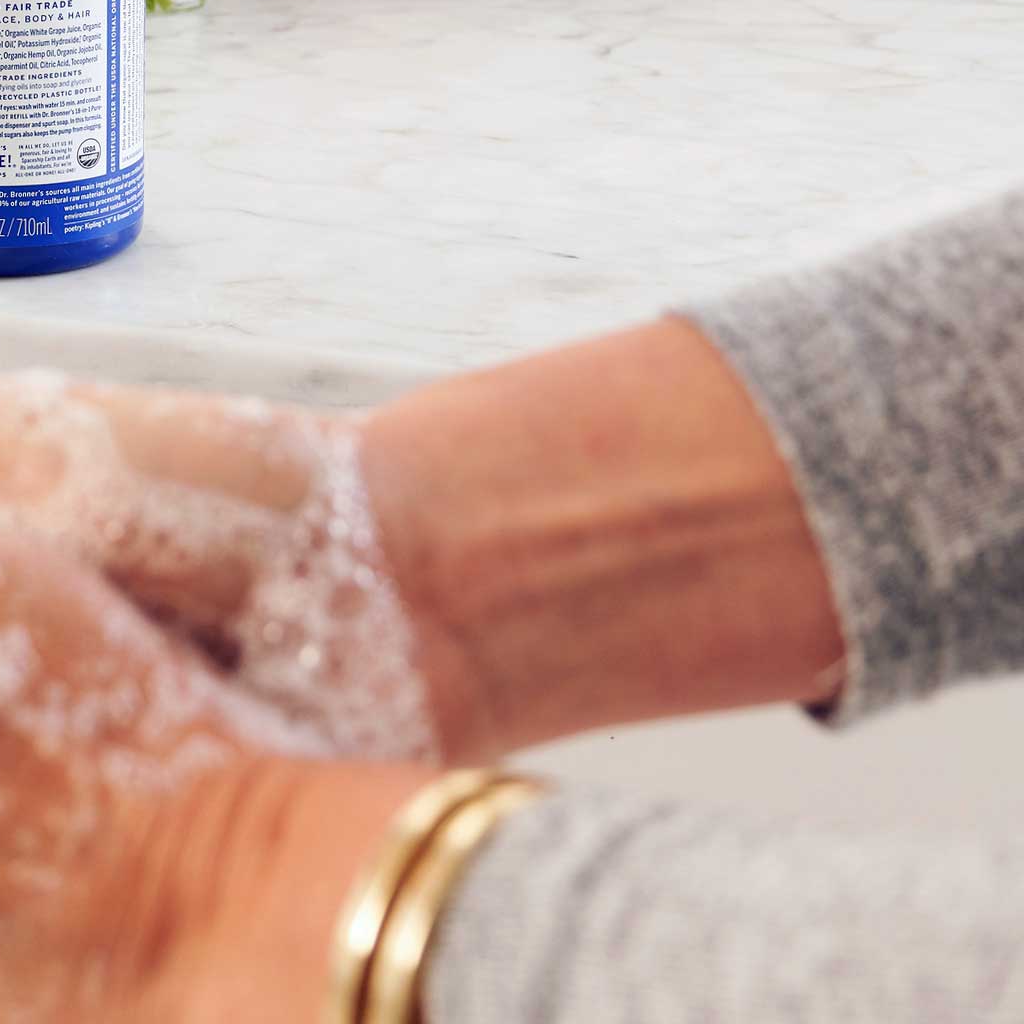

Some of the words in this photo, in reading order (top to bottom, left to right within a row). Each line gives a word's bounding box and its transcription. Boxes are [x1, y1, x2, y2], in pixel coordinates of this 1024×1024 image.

[5, 2, 31, 11] FAIR
[36, 0, 73, 10] TRADE
[25, 14, 54, 23] BODY
[68, 10, 90, 19] HAIR
[5, 30, 28, 38] Organic
[49, 28, 65, 36] Grape
[18, 40, 50, 48] Potassium
[4, 52, 26, 61] Organic
[28, 51, 45, 59] Hemp
[57, 49, 77, 58] Organic
[40, 61, 56, 69] Citric
[28, 70, 82, 80] INGREDIENTS
[41, 90, 72, 98] PLASTIC
[83, 145, 96, 153] USDA
[10, 190, 44, 198] Bronner's
[46, 188, 70, 196] sources
[32, 196, 68, 206] agricultural
